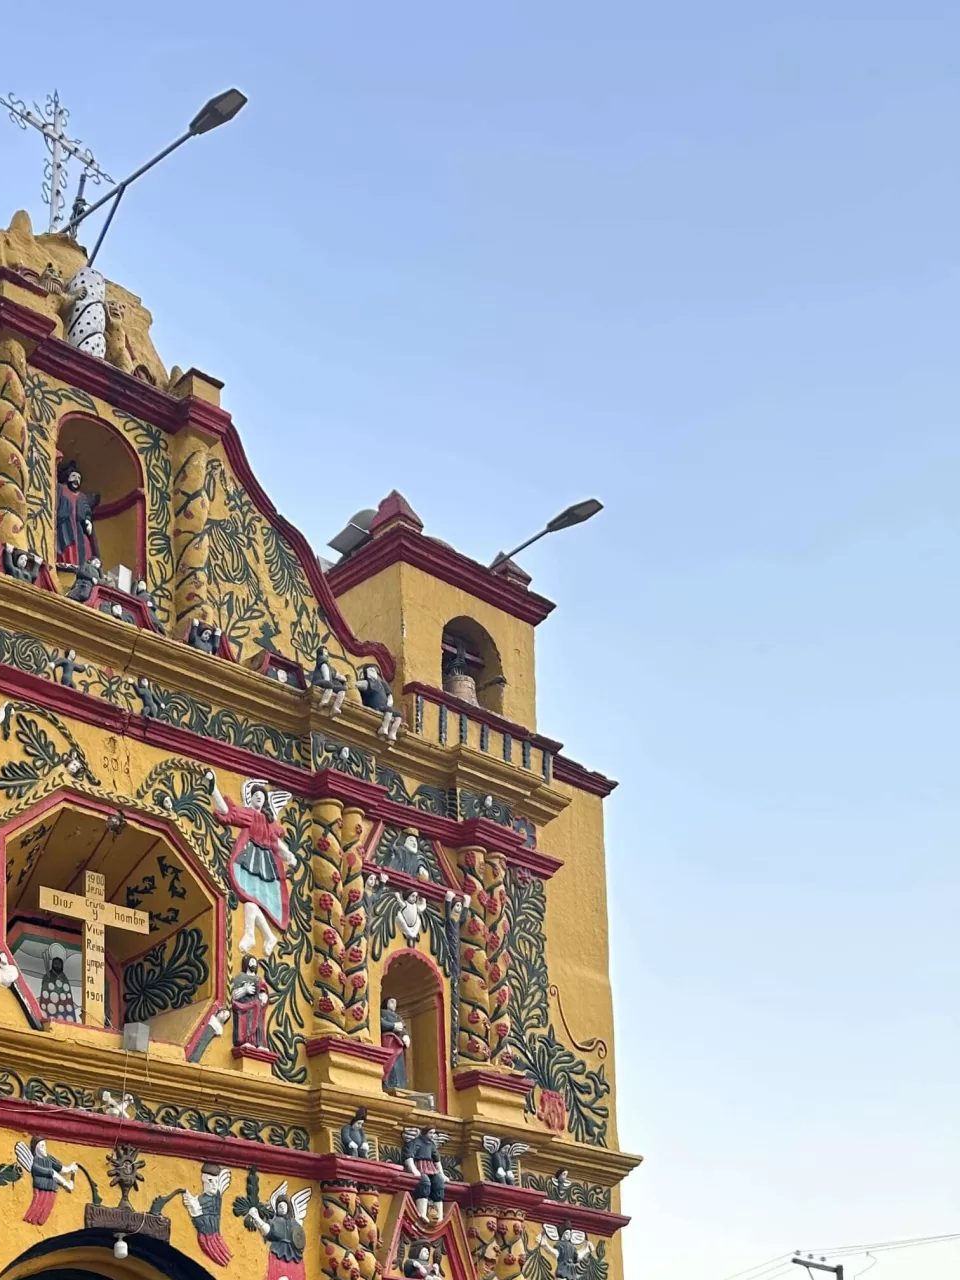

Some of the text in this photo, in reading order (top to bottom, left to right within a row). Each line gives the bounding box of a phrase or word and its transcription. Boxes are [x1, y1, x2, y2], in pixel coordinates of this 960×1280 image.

[87, 873, 105, 886] 1900
[52, 894, 73, 909] Dios
[114, 906, 146, 926] hombre
[86, 990, 103, 1002] 1901
